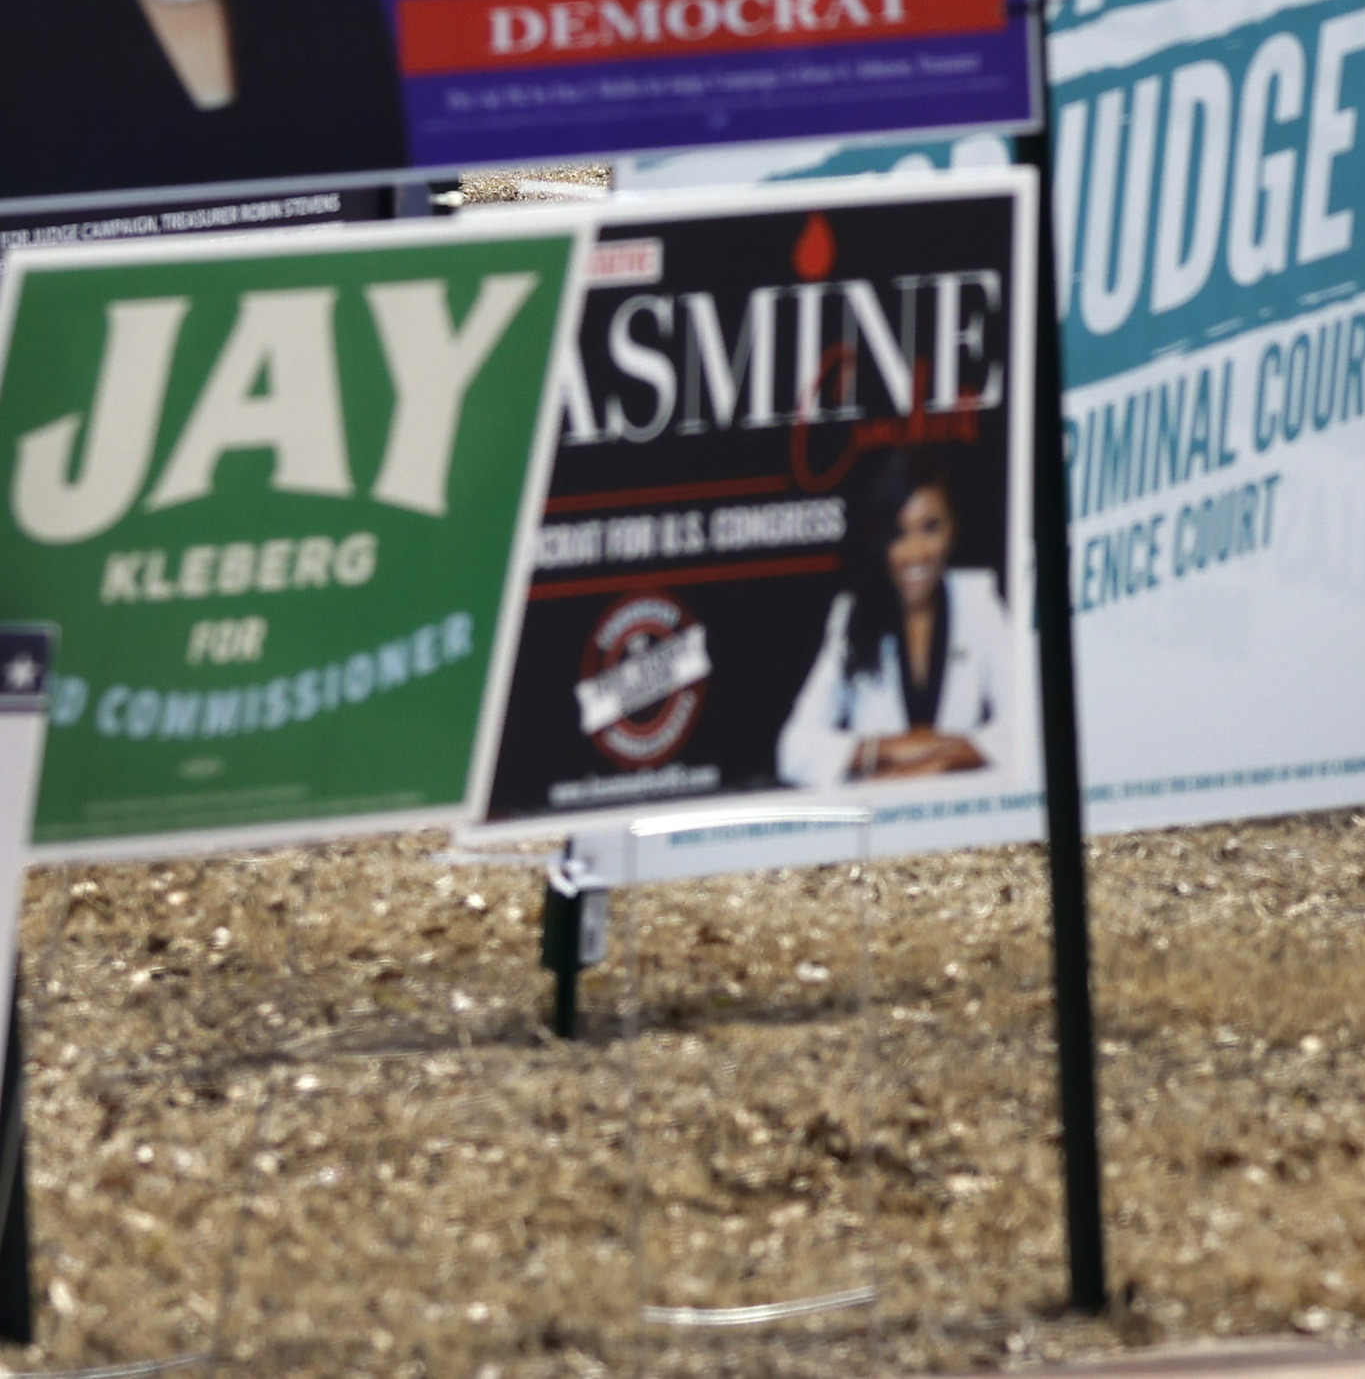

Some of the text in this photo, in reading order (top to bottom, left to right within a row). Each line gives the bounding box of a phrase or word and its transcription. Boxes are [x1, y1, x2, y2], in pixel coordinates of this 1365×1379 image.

[12, 270, 542, 546] JAY
[102, 530, 379, 605] KLEBERG
[1172, 472, 1282, 579] COURT
[97, 609, 475, 742] COMMISSIONER
[187, 615, 269, 665] FOR
